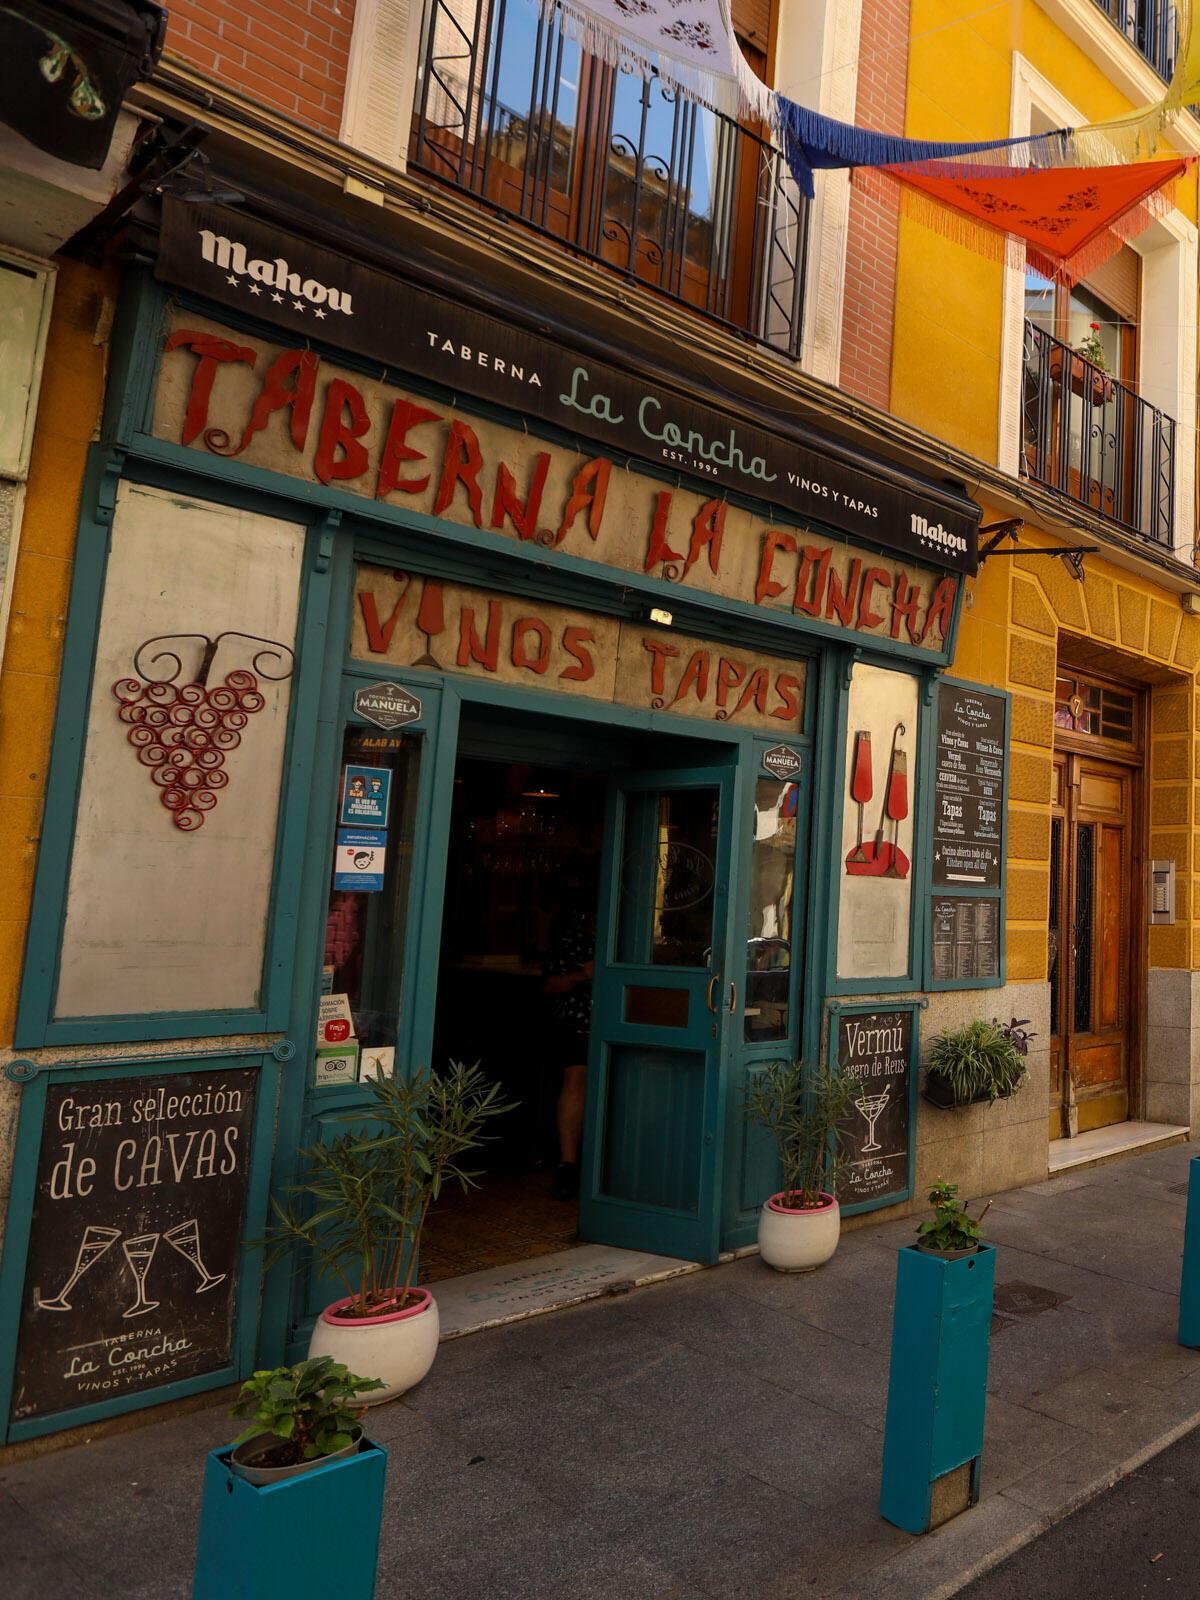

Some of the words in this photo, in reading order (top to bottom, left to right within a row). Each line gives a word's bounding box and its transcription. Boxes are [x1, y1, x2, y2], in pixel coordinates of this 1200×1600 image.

[198, 230, 354, 315] Mahou
[427, 332, 542, 387] TABERNA
[559, 367, 624, 424] La
[638, 396, 778, 482] Concha
[787, 471, 828, 497] VINOS
[831, 490, 840, 502] Y
[843, 494, 879, 518] TAPAS
[662, 448, 688, 465] EST.
[693, 460, 718, 475] 1996
[164, 329, 612, 548] TABERNA
[645, 490, 728, 583] LA
[756, 531, 958, 647] CONCHA
[910, 513, 967, 552] Mahou
[643, 637, 801, 721] TAPAS
[359, 697, 417, 714] MANUELA
[954, 702, 965, 714] La
[966, 705, 992, 720] Concha
[1073, 698, 1081, 714] 7
[766, 756, 799, 768] MANUELA
[942, 800, 963, 821] Tapas
[977, 805, 996, 825] Tapas
[845, 1019, 903, 1058] Vermú
[871, 1056, 882, 1077] de
[884, 1056, 905, 1075] Reus
[58, 1097, 122, 1132] Gran
[131, 1084, 242, 1124] selección
[50, 1142, 96, 1200] de
[114, 1126, 239, 1191] CAVAS
[849, 1171, 863, 1184] La
[864, 1165, 894, 1181] Concha
[104, 1328, 162, 1347] TABERNA
[64, 1356, 101, 1379] La
[108, 1335, 193, 1367] Concha
[77, 1379, 120, 1391] VINOS
[125, 1376, 132, 1384] Y
[138, 1358, 178, 1380] TAPAS
